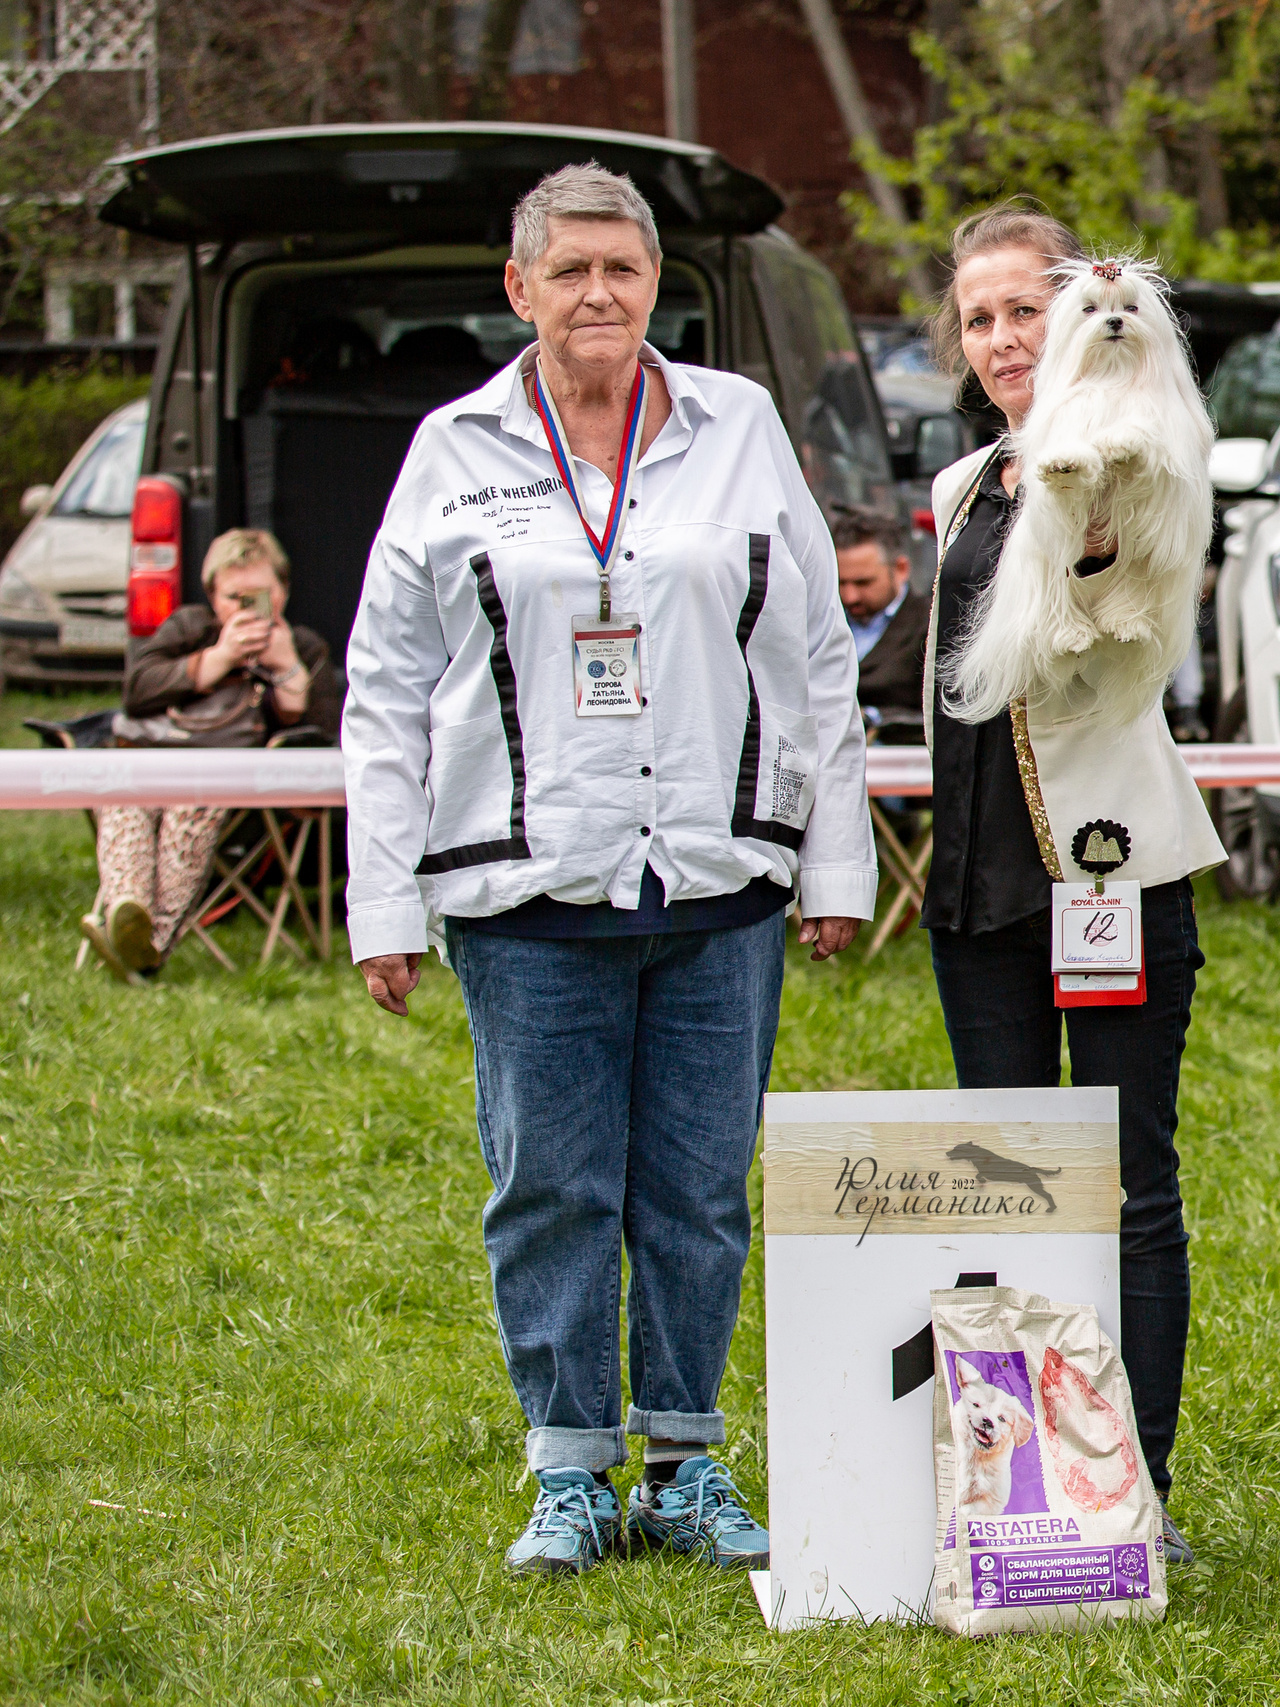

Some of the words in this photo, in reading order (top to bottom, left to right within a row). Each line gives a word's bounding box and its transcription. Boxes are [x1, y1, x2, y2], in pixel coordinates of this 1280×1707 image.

[442, 500, 458, 517] DIL
[459, 486, 499, 506] SMOKE
[594, 681, 622, 689] ЕГОРОВА
[586, 698, 632, 706] ЛЕОНИДОВНА
[1096, 898, 1121, 906] CANIN
[1083, 911, 1118, 945] 12
[835, 1156, 946, 1191] Юлия
[951, 1178, 976, 1190] 2022
[834, 1182, 1041, 1247] Германика
[984, 1517, 1080, 1537] STATERA
[1014, 1535, 1064, 1545] BALANCE
[1007, 1554, 1109, 1569] СБАЛАНСИРОВАННЫЙ
[1008, 1570, 1039, 1580] КОРМ
[1040, 1569, 1063, 1580] ДЛЯ
[1065, 1566, 1110, 1577] ЩЕНКОВ
[1009, 1589, 1018, 1598] С
[1019, 1585, 1092, 1599] ЦЫПЛЕНКОМ
[1126, 1584, 1133, 1594] 3
[1135, 1585, 1146, 1593] кг
